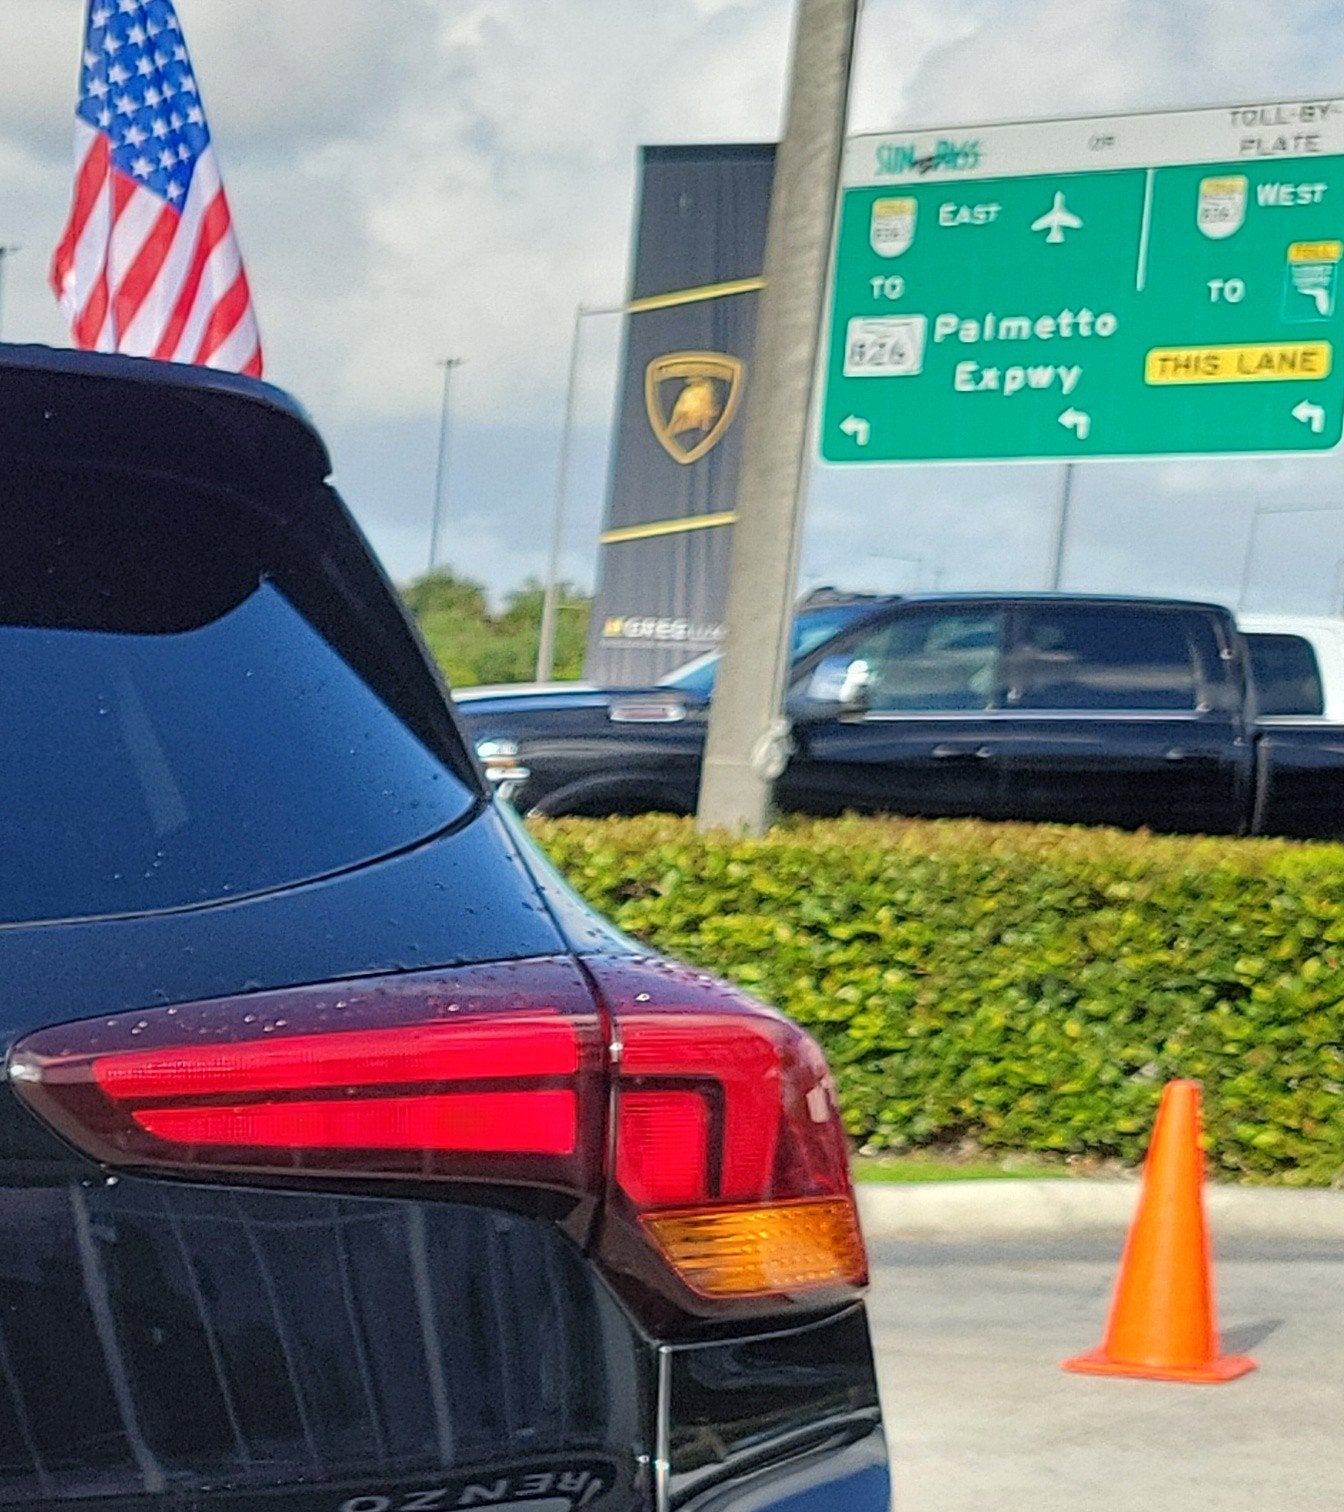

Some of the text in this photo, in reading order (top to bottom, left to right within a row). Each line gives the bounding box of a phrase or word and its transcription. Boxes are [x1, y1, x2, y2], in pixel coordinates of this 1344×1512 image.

[1239, 135, 1320, 156] PLATE
[1257, 182, 1328, 207] WEST
[939, 202, 1002, 227] EAST
[870, 275, 905, 300] TO
[1207, 278, 1245, 303] TO
[933, 307, 1118, 343] Palmetto
[1158, 350, 1318, 377] THIS LANE
[954, 360, 1083, 396] Expwy
